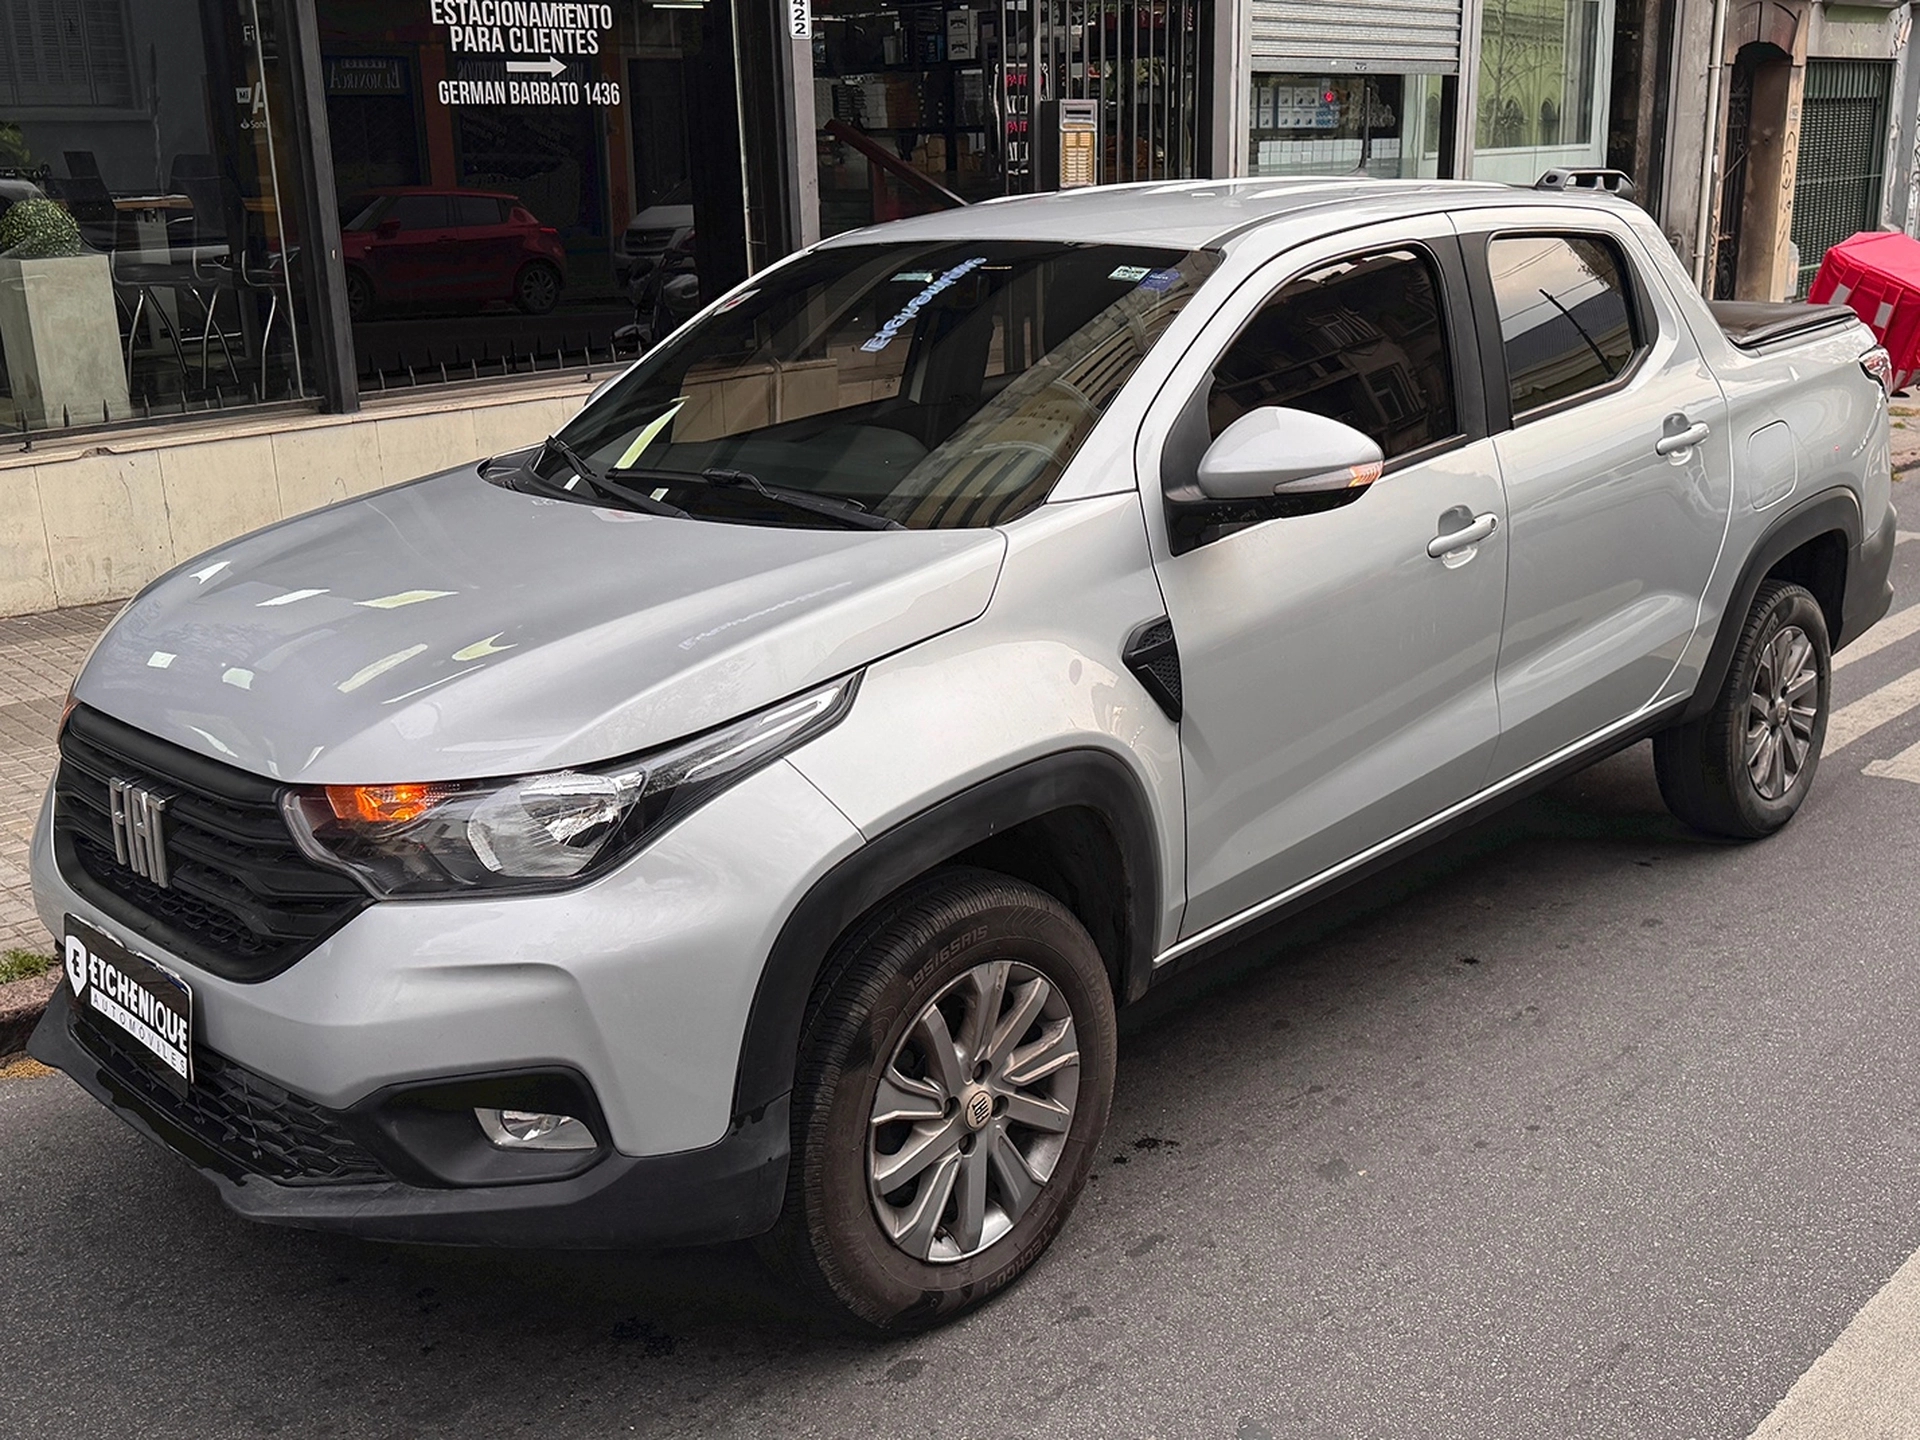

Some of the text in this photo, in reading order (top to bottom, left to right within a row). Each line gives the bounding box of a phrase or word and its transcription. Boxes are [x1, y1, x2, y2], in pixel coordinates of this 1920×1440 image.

[431, 0, 612, 29] ESTACIONAMIENTO
[450, 26, 599, 55] PARA CLIENTES
[438, 81, 620, 105] GERMAN BARBATO 1436
[109, 777, 169, 889] FIAT
[907, 925, 988, 990] 195/65R15
[88, 952, 188, 1054] ETCHENIQUE
